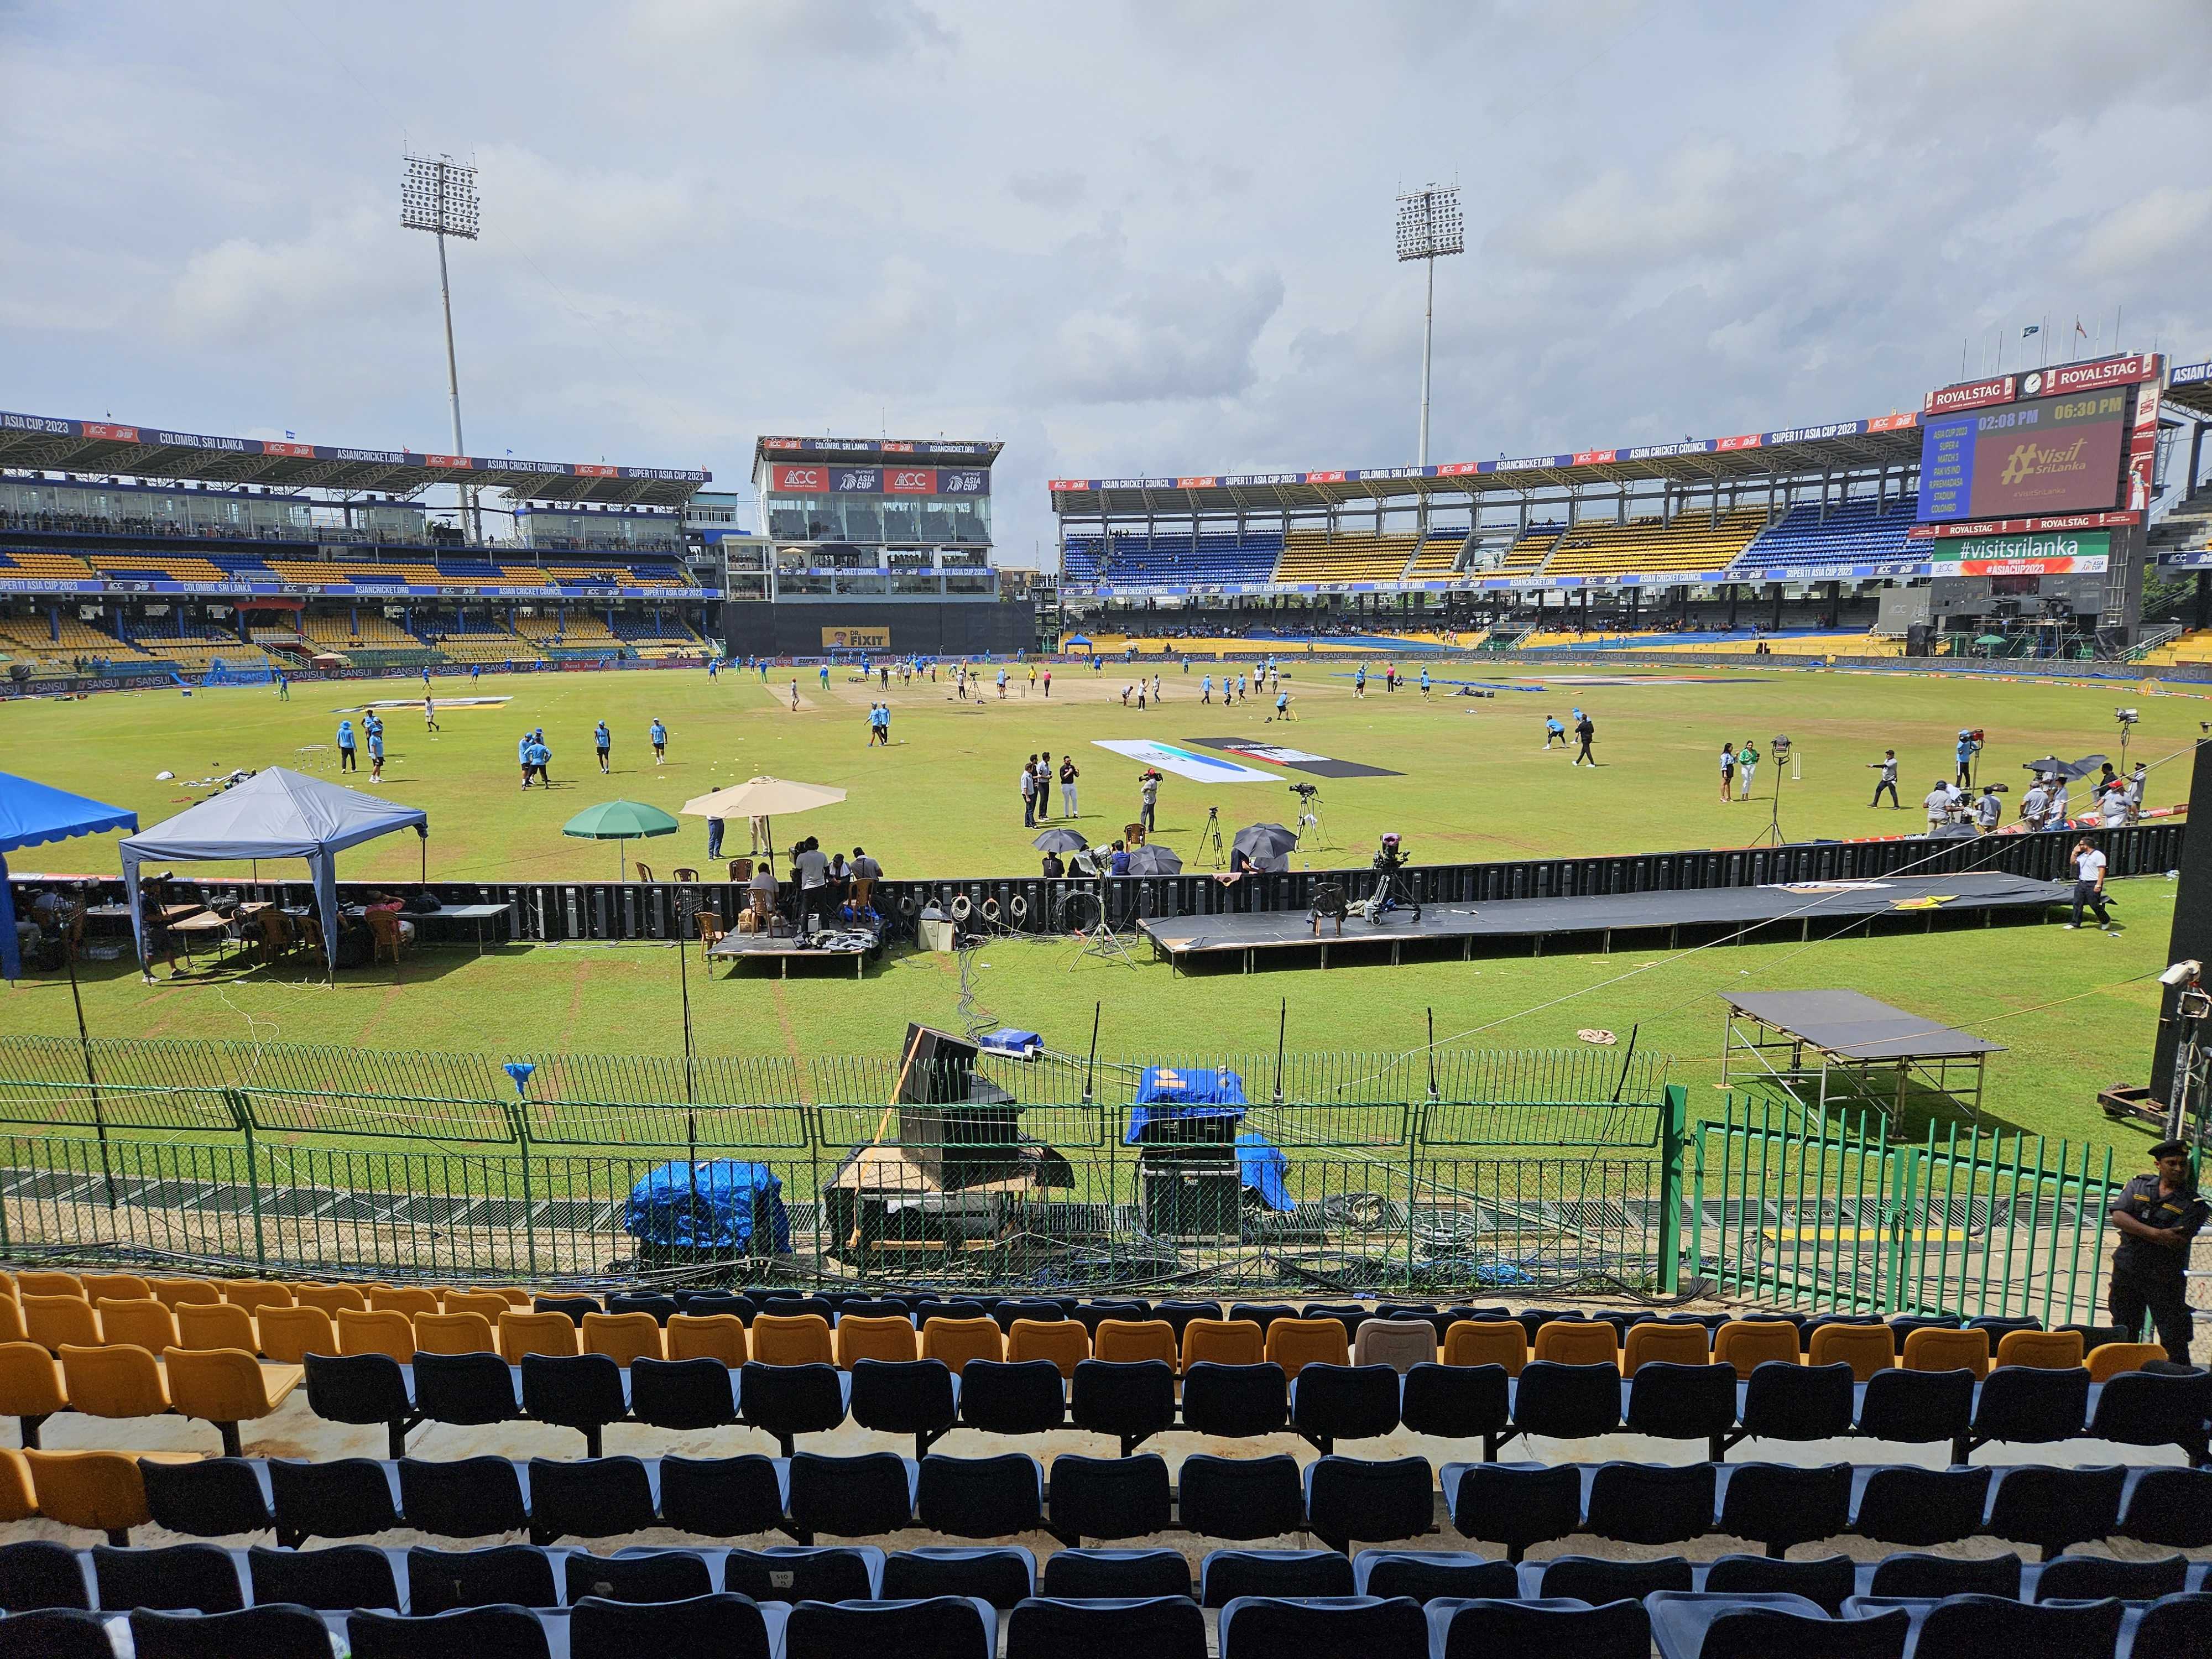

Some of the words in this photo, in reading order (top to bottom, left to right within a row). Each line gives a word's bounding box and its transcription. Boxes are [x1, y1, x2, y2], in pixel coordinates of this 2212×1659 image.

[2173, 364, 2205, 383] ASIAN
[2054, 400, 2096, 420] 06:30
[2099, 397, 2123, 414] PM
[6, 415, 25, 428] ASIA
[27, 418, 43, 430] CUP
[46, 420, 69, 434] 2023
[1978, 413, 2015, 430] 02:08
[2018, 409, 2038, 425] PM
[1804, 429, 1820, 440] ASIA
[1822, 425, 1836, 437] CUP
[1838, 422, 1856, 435] 2023
[1933, 431, 1944, 440] ASIA
[1945, 429, 1955, 437] CUP
[1956, 427, 1968, 436] 2023
[160, 433, 201, 447] COLOMBO,
[203, 437, 215, 448] SRI
[217, 439, 244, 451] LANKA
[1939, 442, 1955, 451] SUPER
[1630, 447, 1650, 458] ASIAN
[1651, 444, 1677, 457] CRICKET
[1679, 441, 1707, 455] COUNCIL
[337, 449, 404, 463] ASIANCRICKET.ORG
[1938, 454, 1955, 463] MATCH
[487, 460, 508, 470] ASIAN
[509, 461, 535, 472] CRICKET
[538, 462, 566, 473] COUNCIL
[1496, 457, 1555, 471] ASIANCRICKET.ORG
[2035, 461, 2086, 474] SriLanka
[659, 470, 672, 479] ASIA
[674, 471, 686, 480] CUP
[688, 472, 704, 481] 2023
[1360, 469, 1390, 479] COLOMBO,
[1392, 468, 1401, 477] SRI
[1402, 467, 1423, 477] LANKA
[1934, 467, 1944, 476] PAK
[784, 470, 817, 484] ACC
[894, 472, 926, 486] ACC
[1254, 476, 1267, 484] ASIA
[1268, 475, 1280, 483] CUP
[1281, 474, 1296, 483] 2023
[1102, 480, 1119, 488] ASIAN
[1120, 479, 1144, 488] CRICKET
[1145, 479, 1170, 488] COUNCIL
[1934, 491, 1956, 500] STADIUM
[2013, 488, 2066, 497] #VisitSriLanka
[1931, 503, 1956, 513] COLOMBO
[1960, 535, 2078, 560] #visitsrilanka
[1812, 568, 1824, 577] ASIA
[1825, 568, 1837, 576] CUP
[1838, 567, 1852, 576] 2023
[1986, 563, 2044, 575] #ASIACUP2023
[1510, 578, 1556, 587] ASIANCRICKET.ORG
[1639, 575, 1655, 583] ASIAN
[1657, 574, 1679, 582] CRICKET
[28, 581, 43, 590] ASIA
[45, 581, 58, 591] CUP
[60, 581, 78, 591] 2023
[184, 583, 217, 593] COLOMBO,
[219, 584, 229, 592] SRI
[231, 585, 252, 593] LANKA
[499, 587, 515, 595] ASIAN
[851, 636, 883, 646] FIXIT
[436, 665, 466, 673] SANSUI
[1985, 662, 2023, 671] SANSUI
[2047, 664, 2085, 674] SANSUI
[293, 670, 325, 679] SANSUI
[340, 668, 372, 677] SANSUI
[2167, 669, 2206, 680] SANSUI
[87, 679, 119, 689] SANSUI
[136, 676, 170, 686] SANSUI
[36, 681, 67, 692] SANSUI
